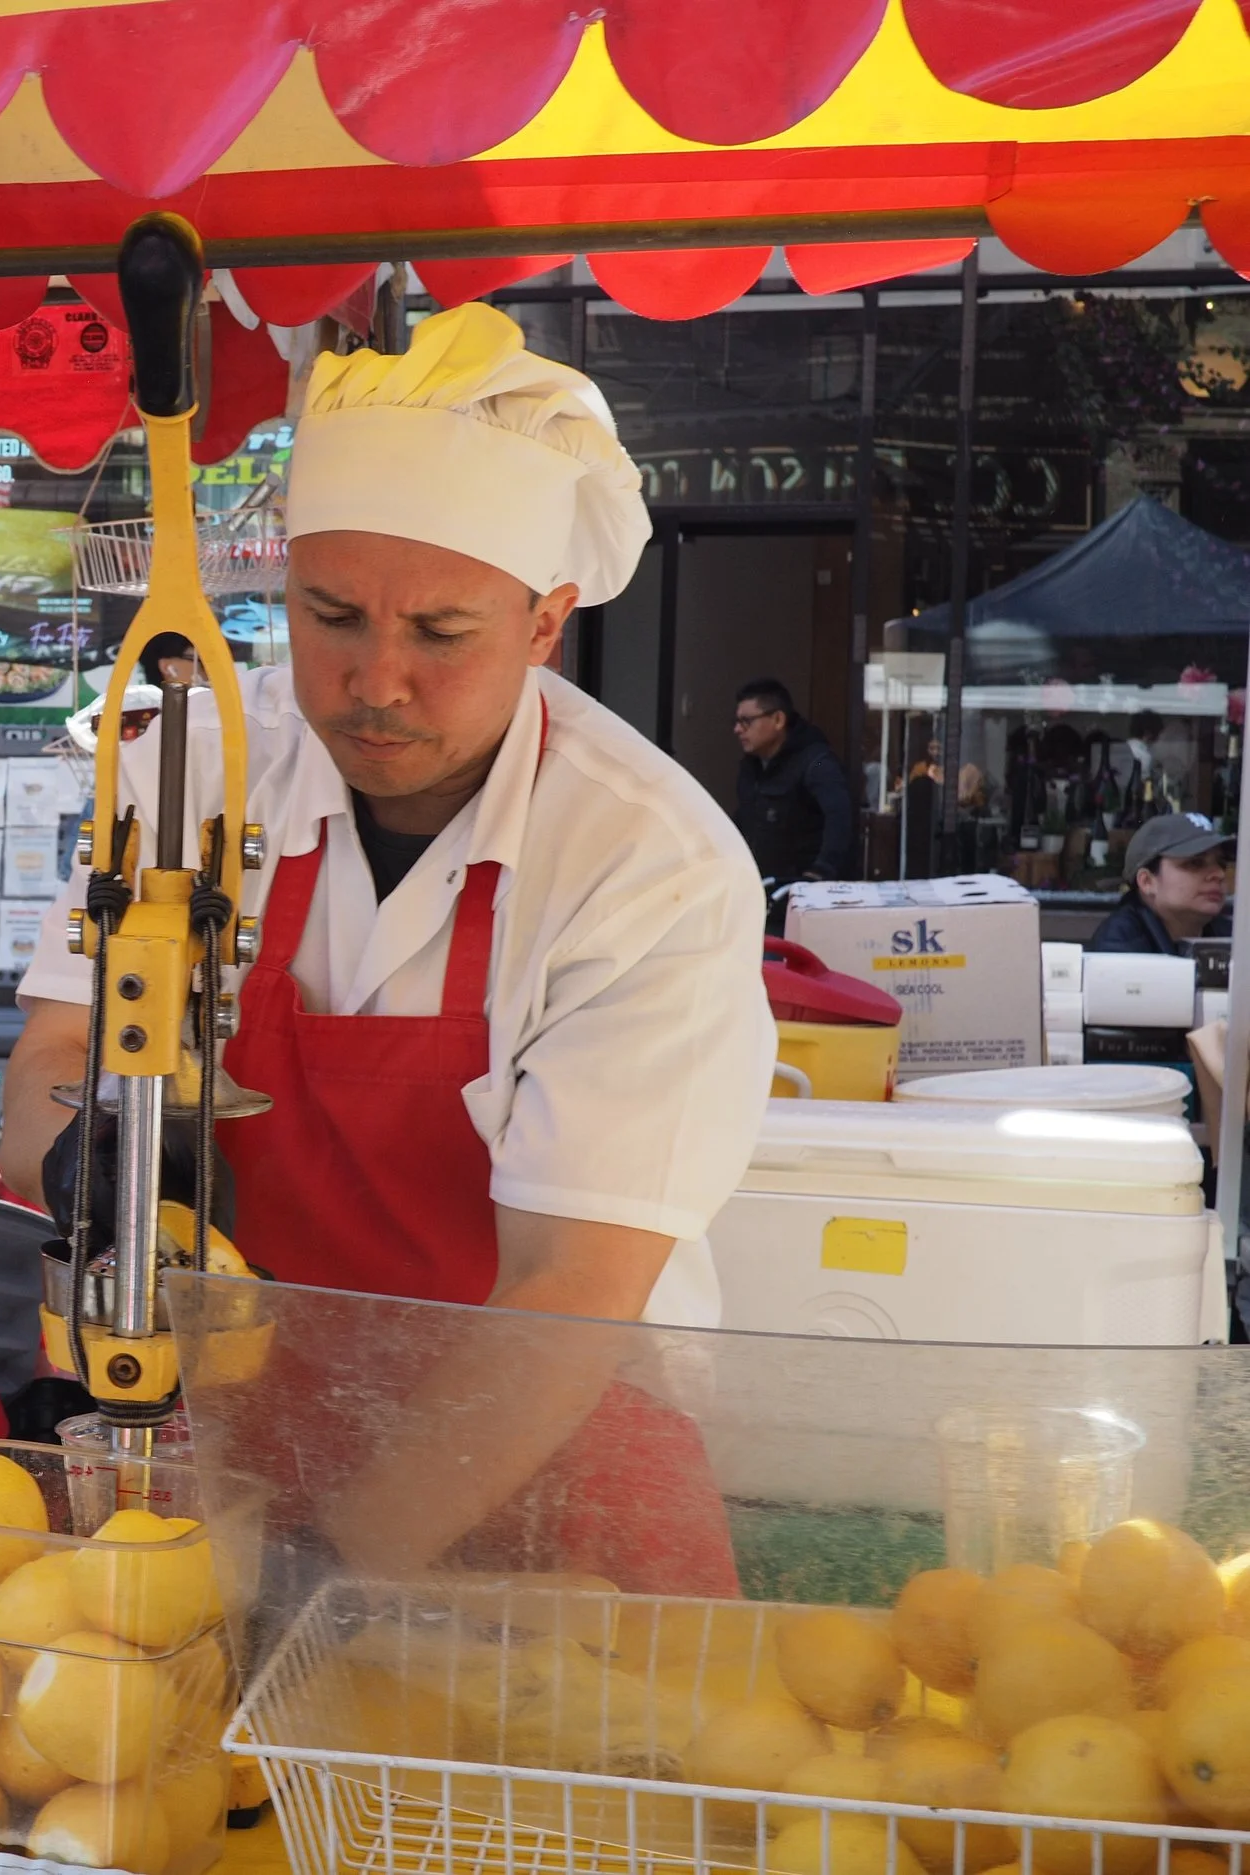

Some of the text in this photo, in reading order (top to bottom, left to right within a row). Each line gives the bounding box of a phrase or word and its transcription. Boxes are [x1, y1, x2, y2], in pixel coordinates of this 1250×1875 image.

[891, 918, 945, 954] sk
[889, 958, 950, 967] LEMONS
[896, 983, 945, 996] SEA COOL
